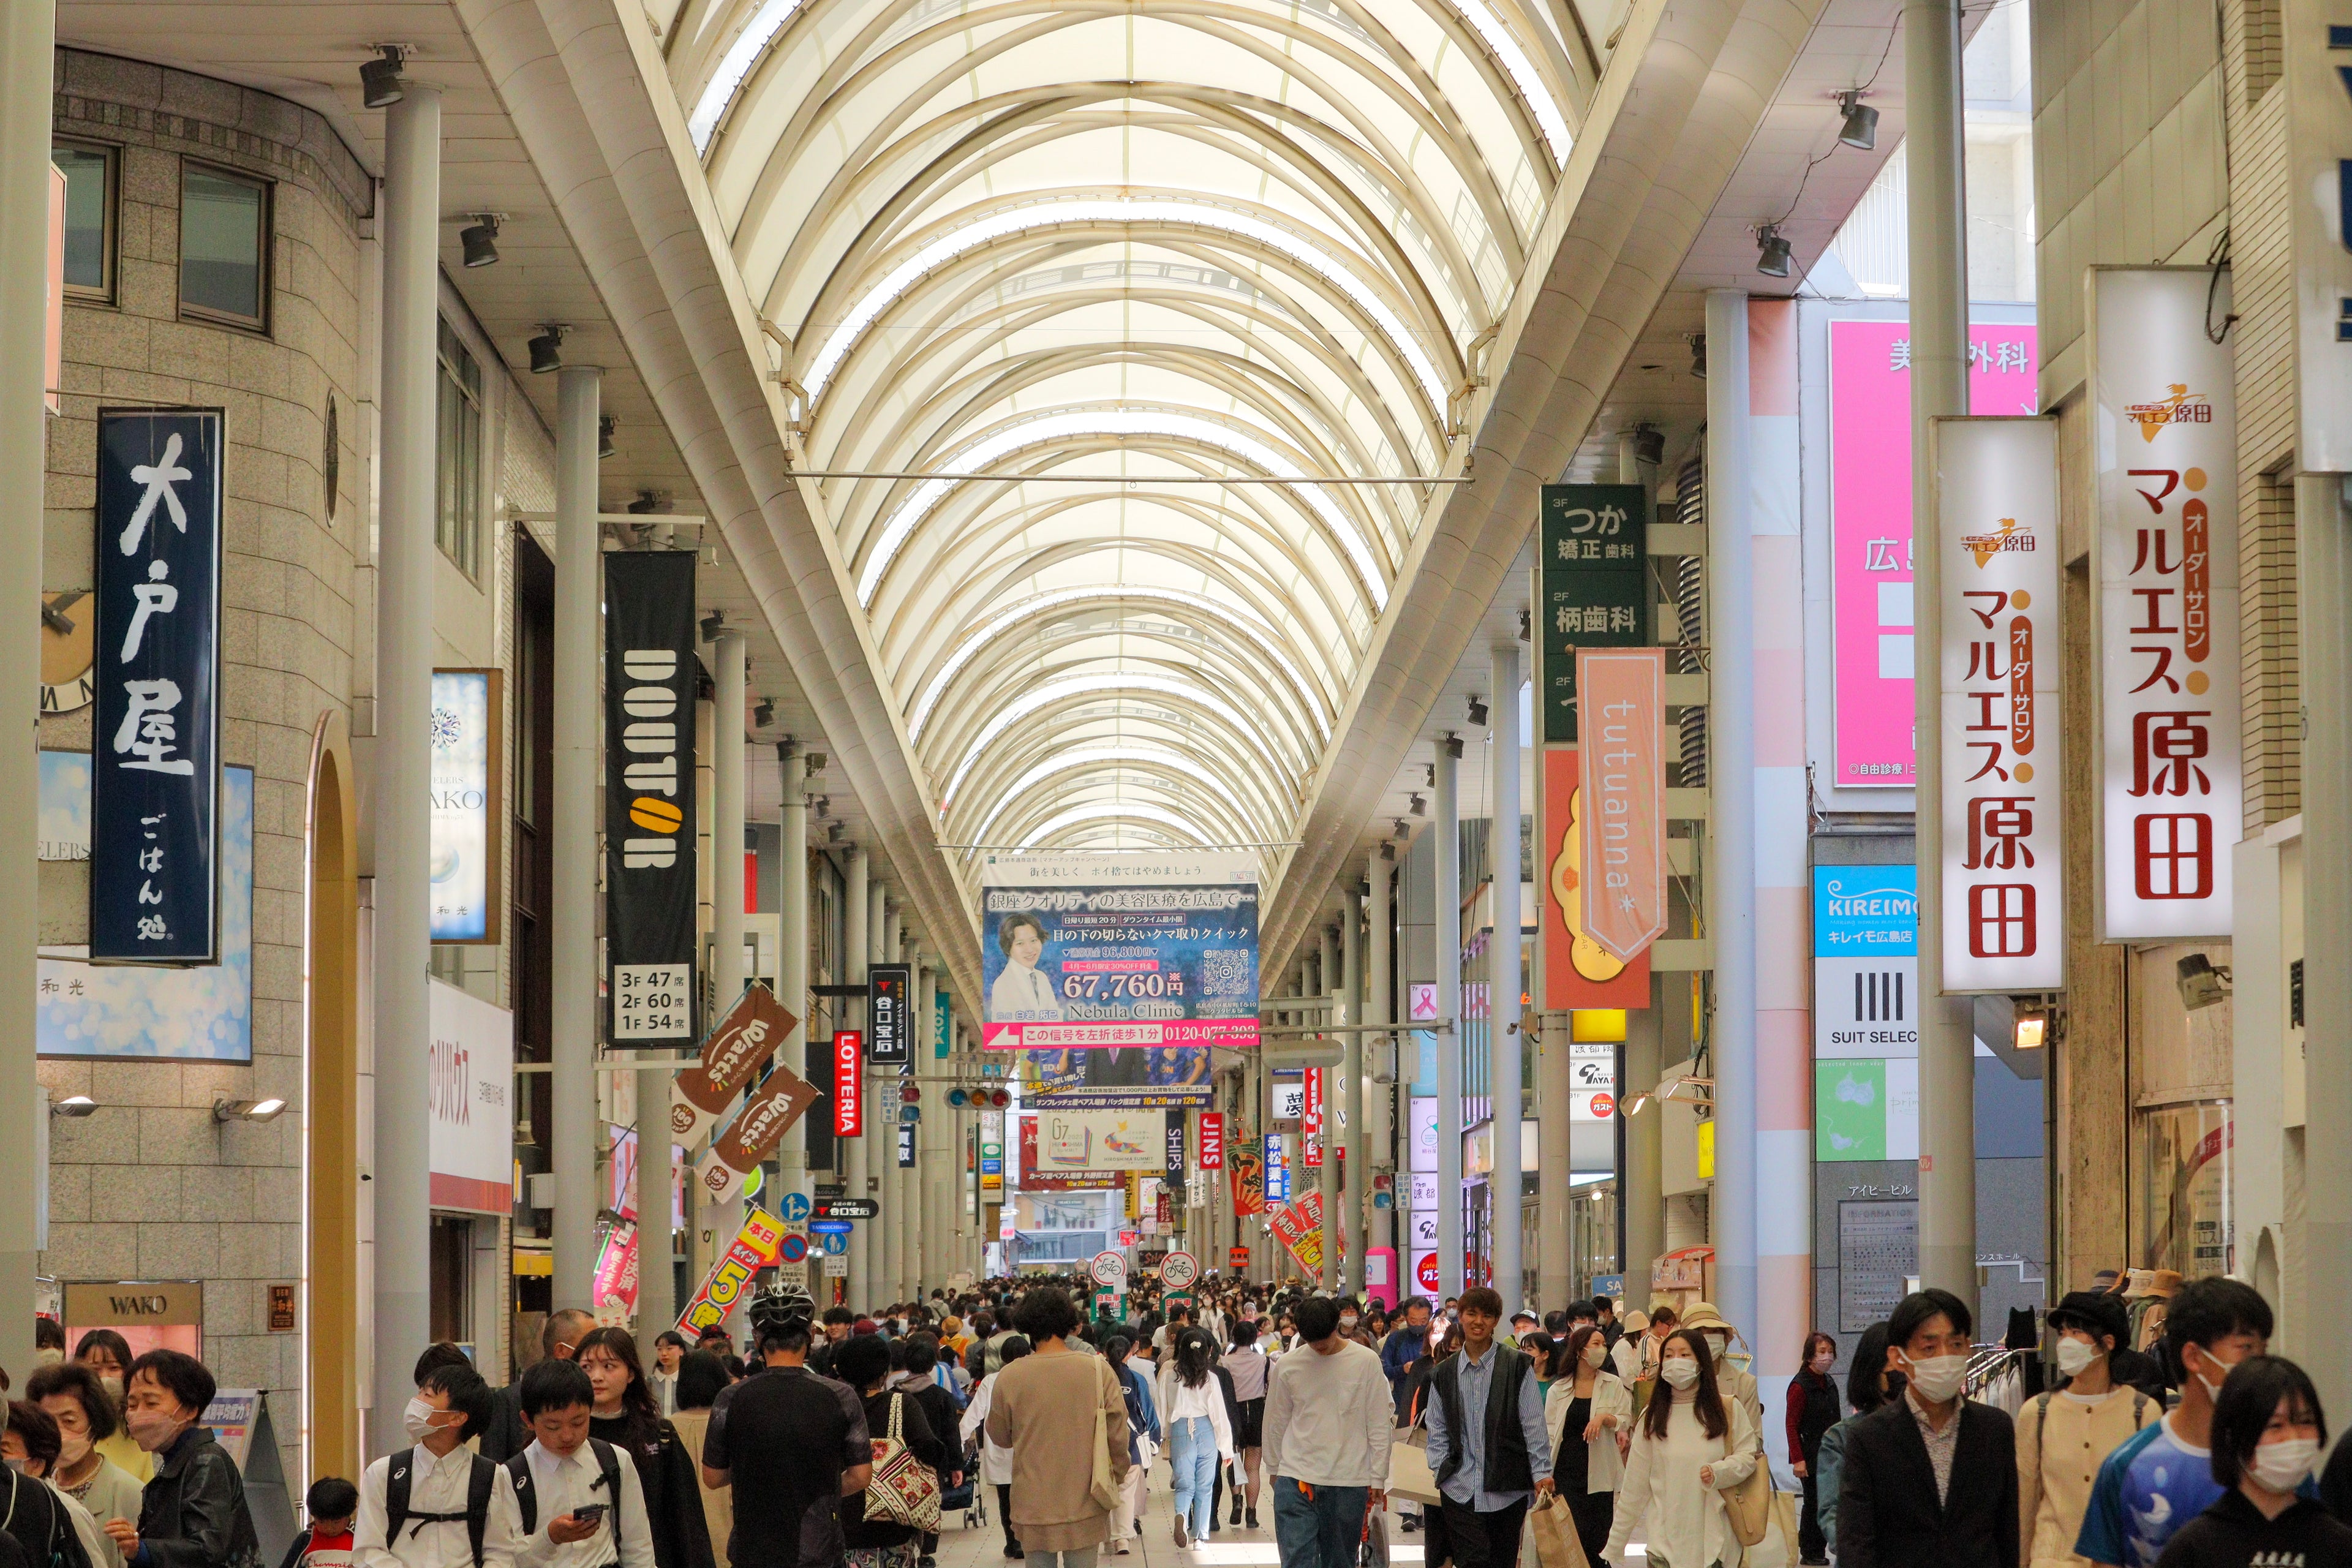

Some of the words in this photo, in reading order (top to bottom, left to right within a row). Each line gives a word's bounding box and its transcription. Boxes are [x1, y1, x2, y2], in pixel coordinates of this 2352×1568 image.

[2125, 404, 2211, 423] マルエス原田
[1553, 499, 1568, 508] 3F
[1564, 505, 1627, 535] つか
[1558, 538, 1602, 560] 矯正
[1605, 543, 1635, 559] 歯科
[1961, 535, 2035, 552] マルエス原田
[2185, 513, 2206, 648] オーダーサロン
[115, 432, 195, 776] 大戸屋
[1554, 592, 1569, 601] 2F
[1556, 606, 1636, 633] 柄歯科
[1556, 677, 1571, 686] 2F
[2013, 627, 2034, 744] オーダーサロン
[2126, 468, 2214, 901] マルエス原田
[623, 649, 683, 869] DOUTOR
[1961, 590, 2037, 959] マルエス原田
[137, 813, 167, 941] ごはん処
[1053, 926, 1249, 942] 目の下の切らないクマ取りクイック
[1828, 930, 1913, 944] キレイモ広島店
[622, 972, 641, 987] 3F
[622, 993, 641, 1009] 2F
[1015, 1011, 1035, 1020] 白岩
[1069, 1005, 1128, 1019] Nebula
[1133, 1003, 1183, 1018] Clinic
[622, 1014, 641, 1030] 1F
[875, 996, 893, 1053] 谷口宝石
[1026, 1028, 1159, 1041] この信号を左折徒歩1分
[1165, 1024, 1256, 1041] 0120-077-393
[1831, 1031, 1866, 1044] SUIT
[1869, 1030, 1917, 1043] SELEC
[840, 1035, 855, 1133] LOTTERIA
[1272, 1122, 1285, 1131] 1F
[1168, 1128, 1182, 1171] SHIPS
[1267, 1135, 1281, 1198] 赤松薬局
[1848, 1184, 1913, 1197] アイビービル
[829, 1207, 870, 1216] 谷口宝石
[748, 1222, 776, 1245] 本日
[732, 1244, 760, 1266] ポイント
[109, 1295, 167, 1316] WAKO
